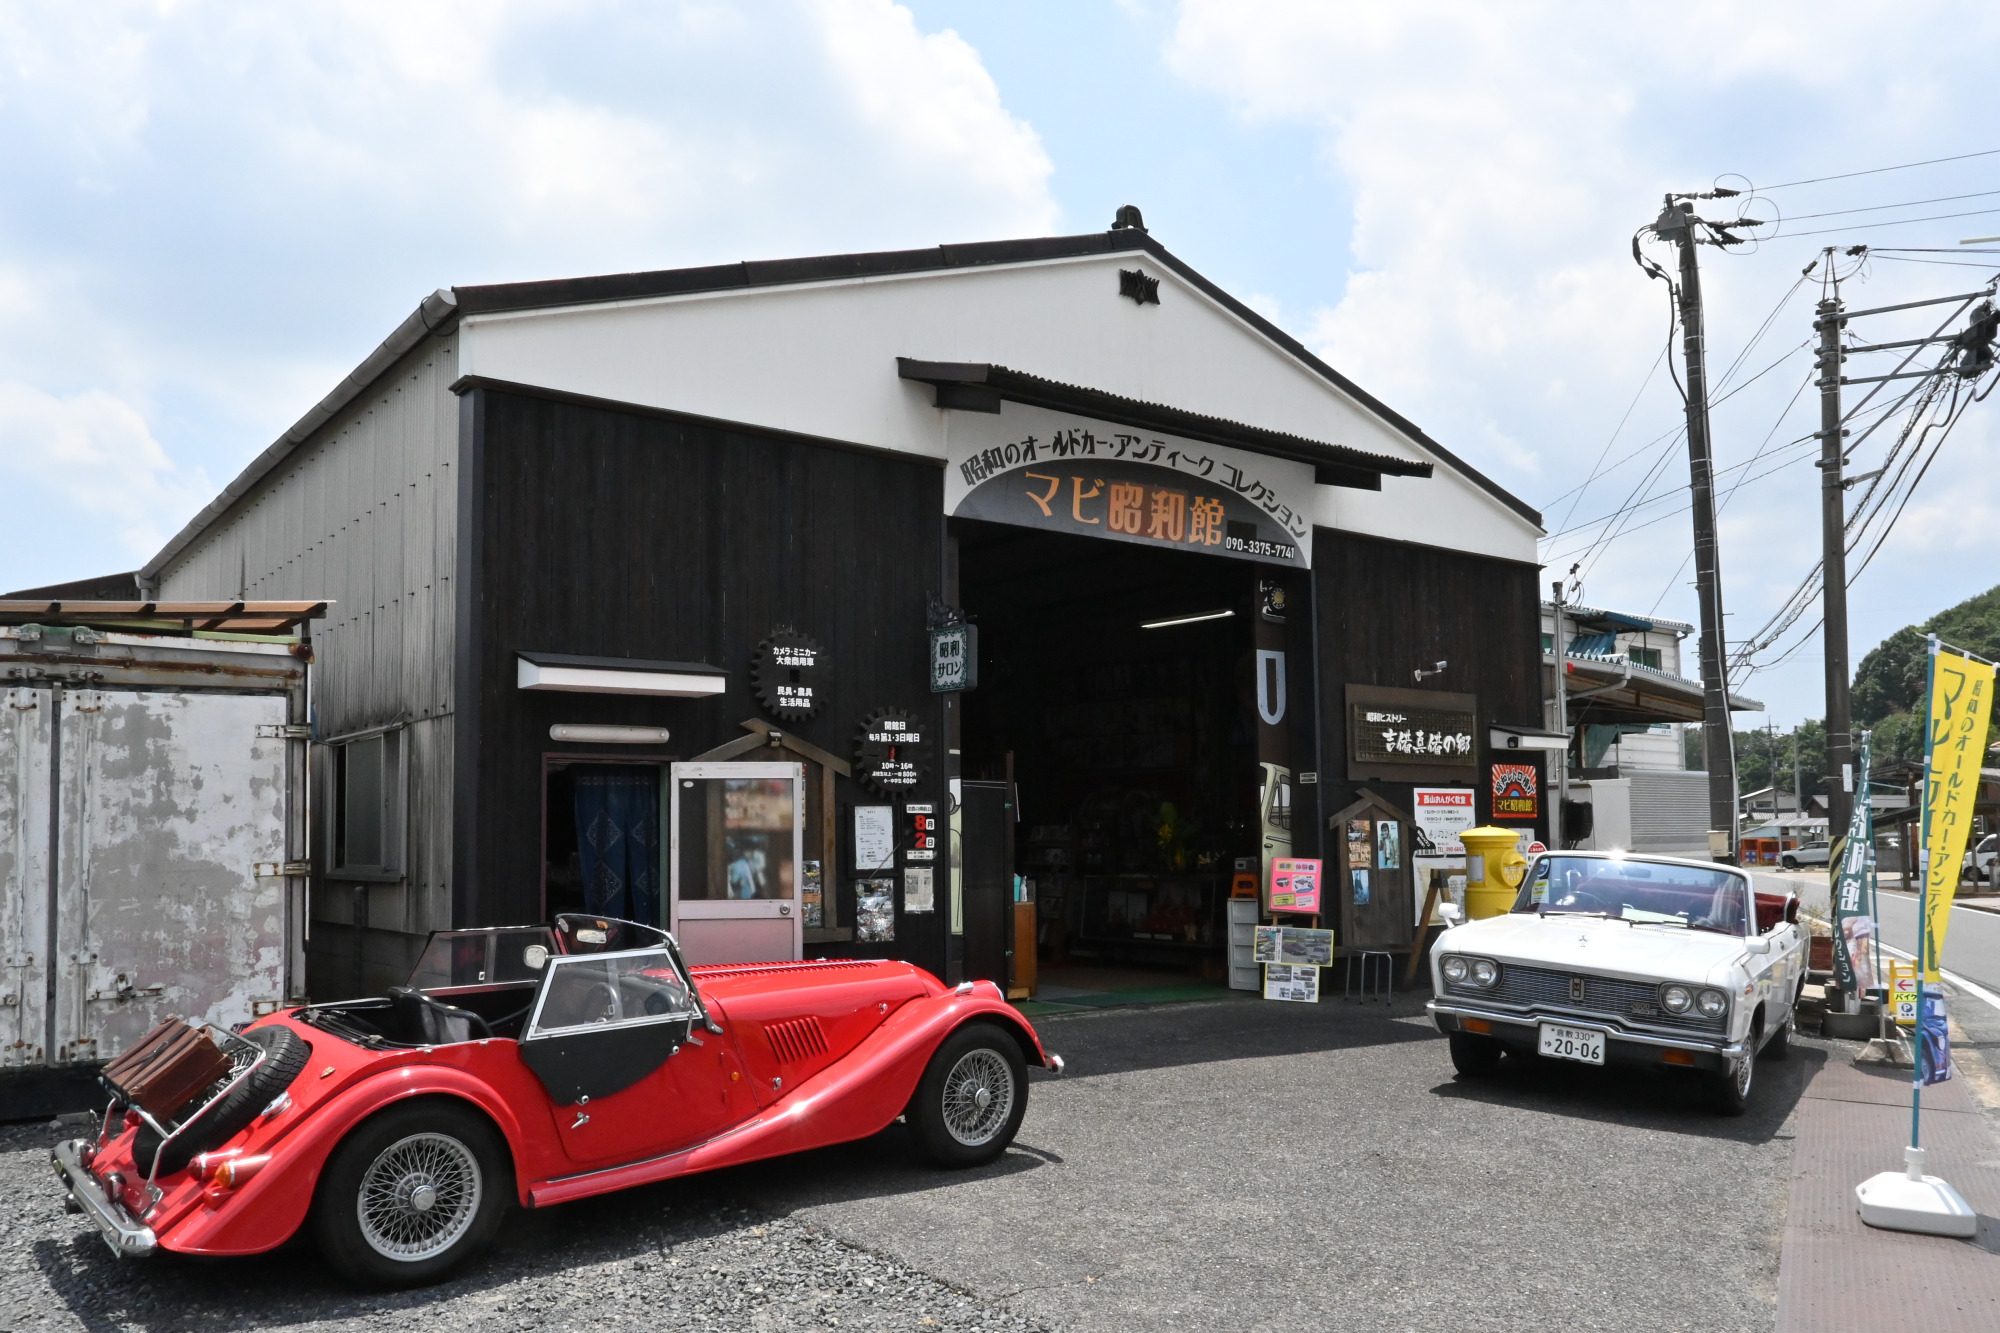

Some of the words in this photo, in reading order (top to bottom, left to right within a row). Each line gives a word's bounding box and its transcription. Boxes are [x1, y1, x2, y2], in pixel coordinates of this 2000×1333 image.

[1218, 462, 1309, 539] コレクション
[1024, 470, 1225, 547] マビ昭和館
[1225, 536, 1295, 559] 090-3375-7741
[773, 646, 817, 657] カメラ・ミニカー
[939, 640, 960, 658] 昭和
[776, 655, 815, 667] 大衆商用車
[937, 660, 962, 679] サロン
[777, 685, 813, 698] 民具・農具
[779, 696, 811, 708] 生活用品
[1366, 711, 1408, 723] 昭和ヒストリー
[884, 720, 906, 731] 開館日
[1381, 727, 1472, 756] 吉備真備の郷
[1423, 794, 1466, 805] 西山おんがく教室
[1496, 799, 1533, 812] マビ昭和館
[915, 814, 934, 831] 8月
[1895, 993, 1918, 1001] バイク
[1554, 1038, 1601, 1060] 20-06
